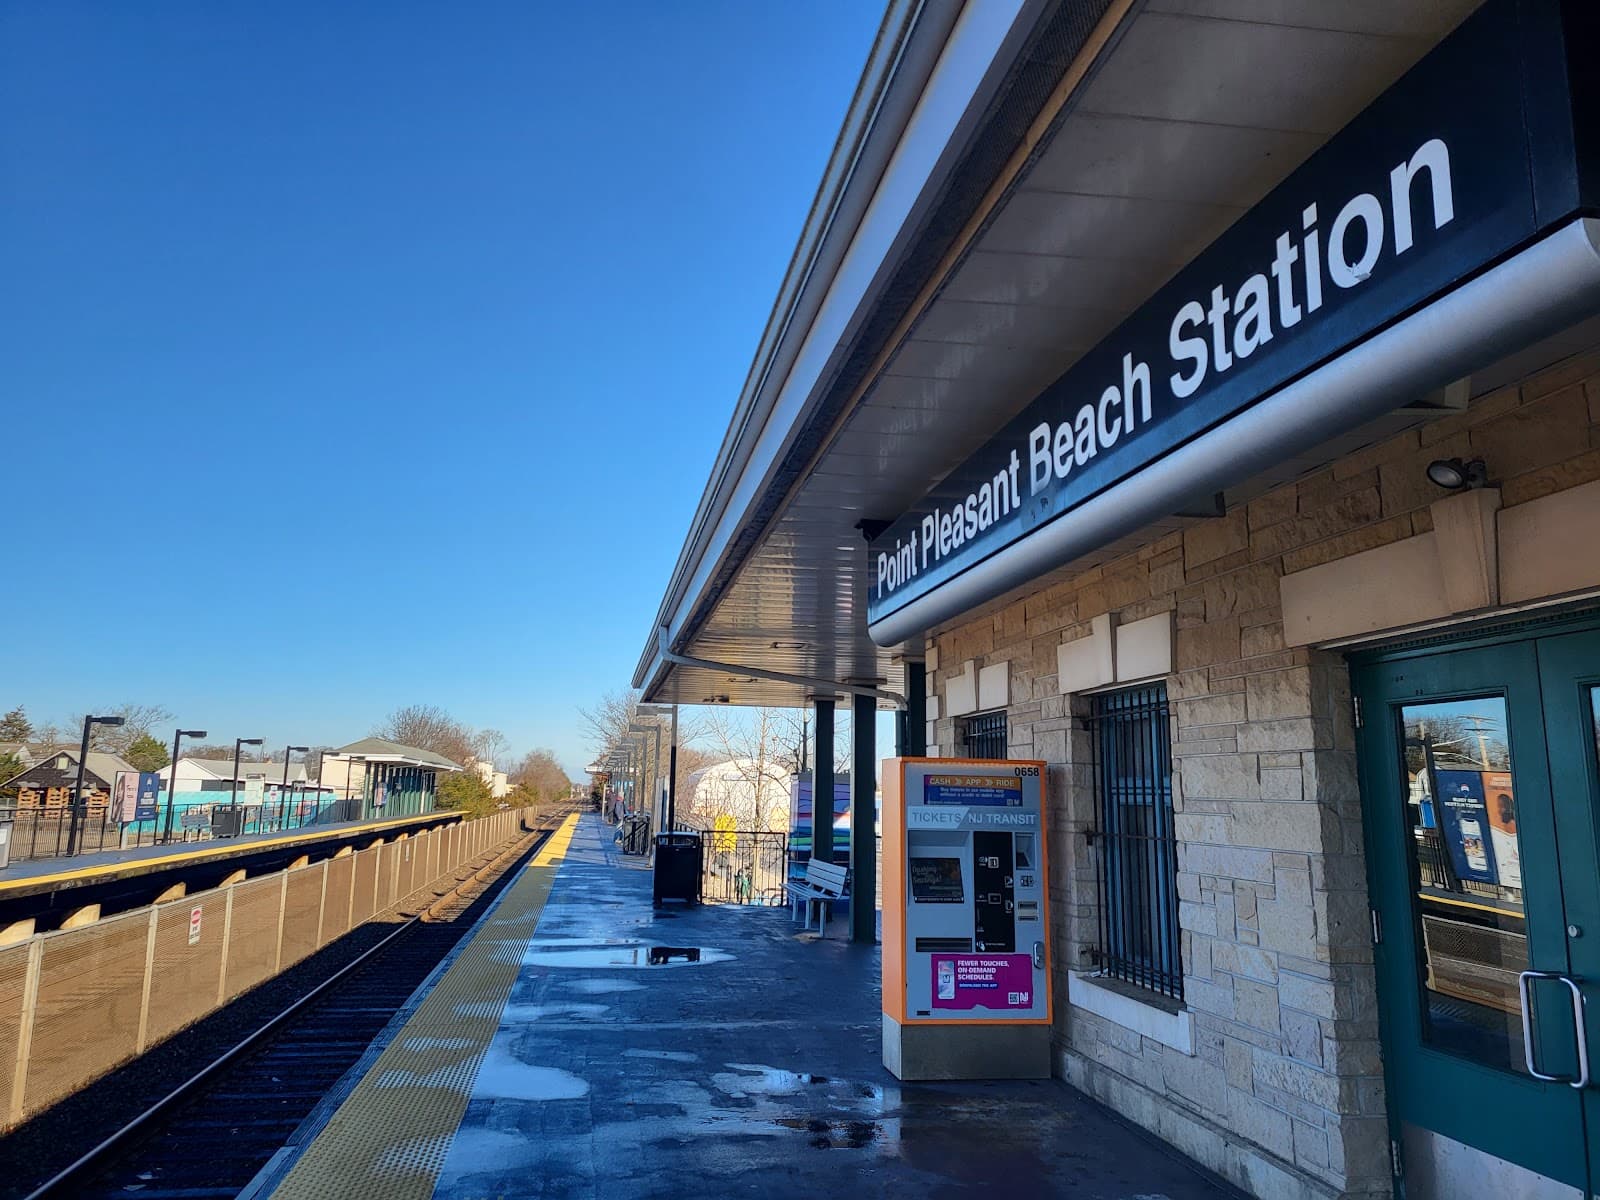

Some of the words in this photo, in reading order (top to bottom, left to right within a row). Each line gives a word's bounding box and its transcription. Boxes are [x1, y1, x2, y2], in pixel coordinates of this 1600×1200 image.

[878, 530, 917, 599] Point
[922, 448, 1021, 570] Pleasant
[1030, 352, 1153, 497] Beach
[1169, 138, 1455, 398] Station
[1014, 767, 1040, 777] 0658
[929, 777, 951, 786] CASH
[966, 778, 981, 786] APP
[996, 779, 1015, 787] RIDE
[911, 812, 962, 823] TICKETS
[968, 813, 983, 824] NJ
[987, 813, 1036, 825] TRANSIT
[980, 960, 1010, 968] TOUCHES,
